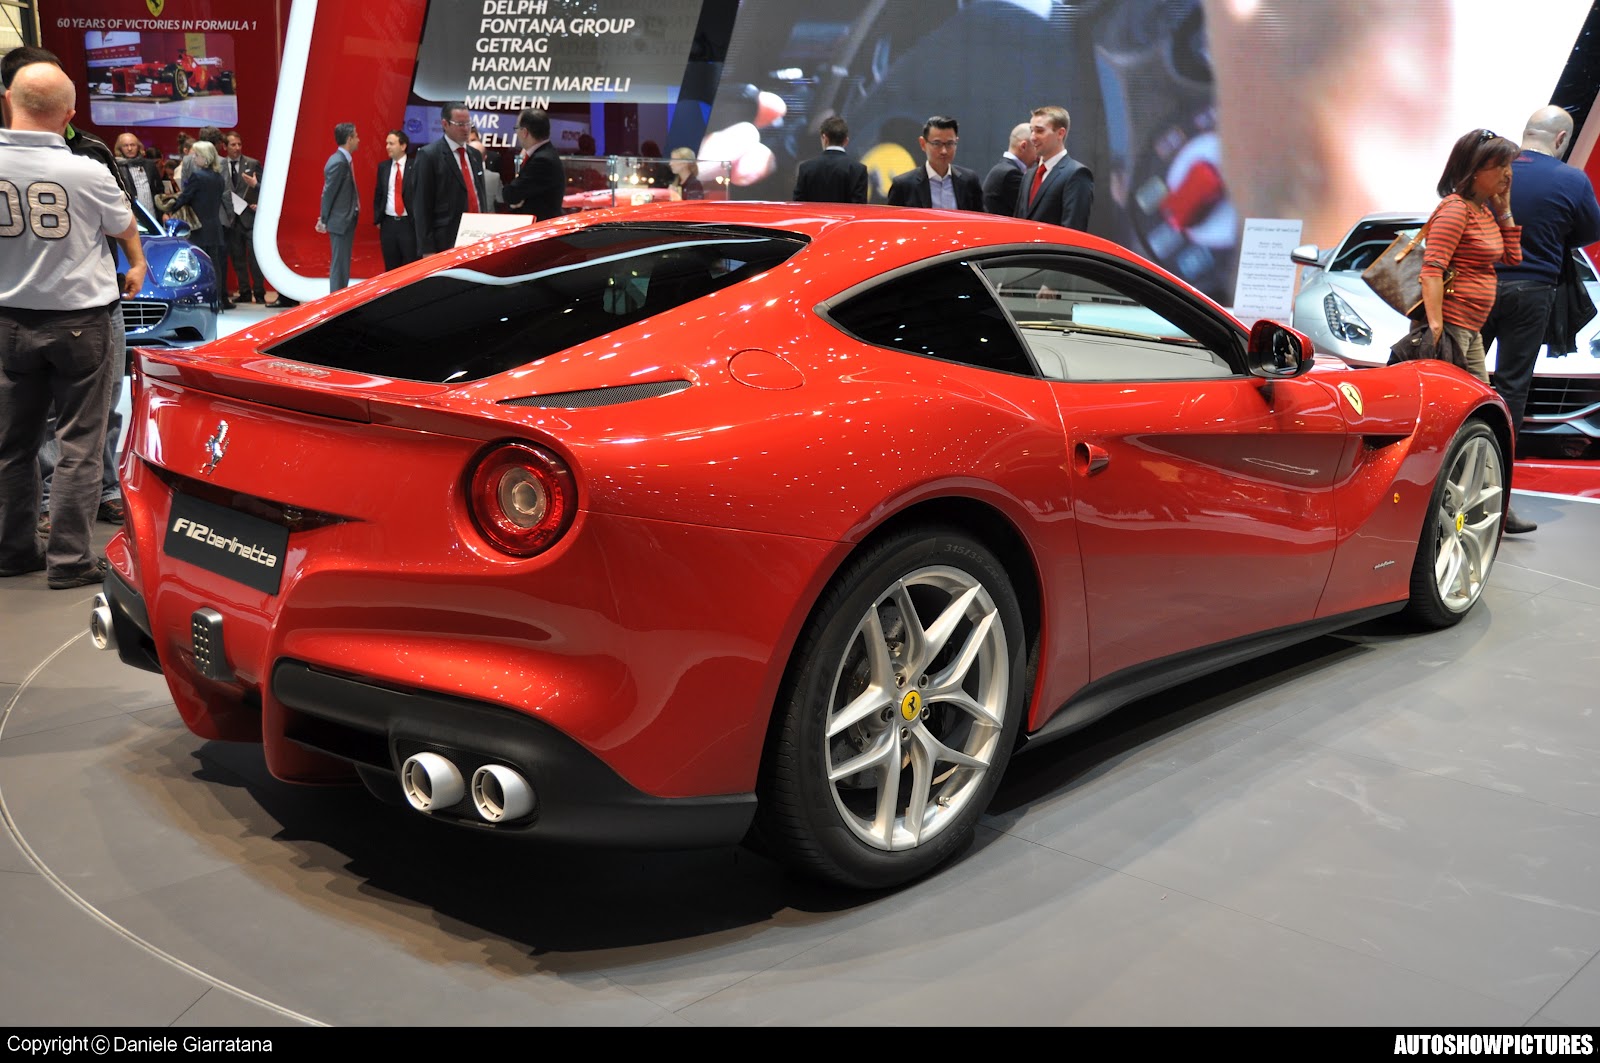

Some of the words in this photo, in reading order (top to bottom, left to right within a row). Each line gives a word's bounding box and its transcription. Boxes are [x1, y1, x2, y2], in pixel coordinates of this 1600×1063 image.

[482, 0, 548, 15] DELPHI
[57, 18, 70, 28] 60
[72, 18, 106, 29] YEARS
[107, 19, 123, 29] OF
[124, 19, 180, 30] VICTORIES
[181, 20, 194, 30] IN
[195, 20, 250, 31] FORMULA
[251, 21, 257, 30] 1
[480, 18, 566, 34] FONTANA
[570, 18, 636, 34] GROUP
[475, 37, 548, 53] GETRAG
[471, 57, 551, 72] HARMAN
[468, 76, 550, 91] MAGNETI
[552, 77, 631, 92] MARELLI
[464, 95, 550, 110] MICHELIN
[470, 113, 499, 129] MR
[479, 132, 518, 148] ELLI
[943, 544, 985, 563] 315/35
